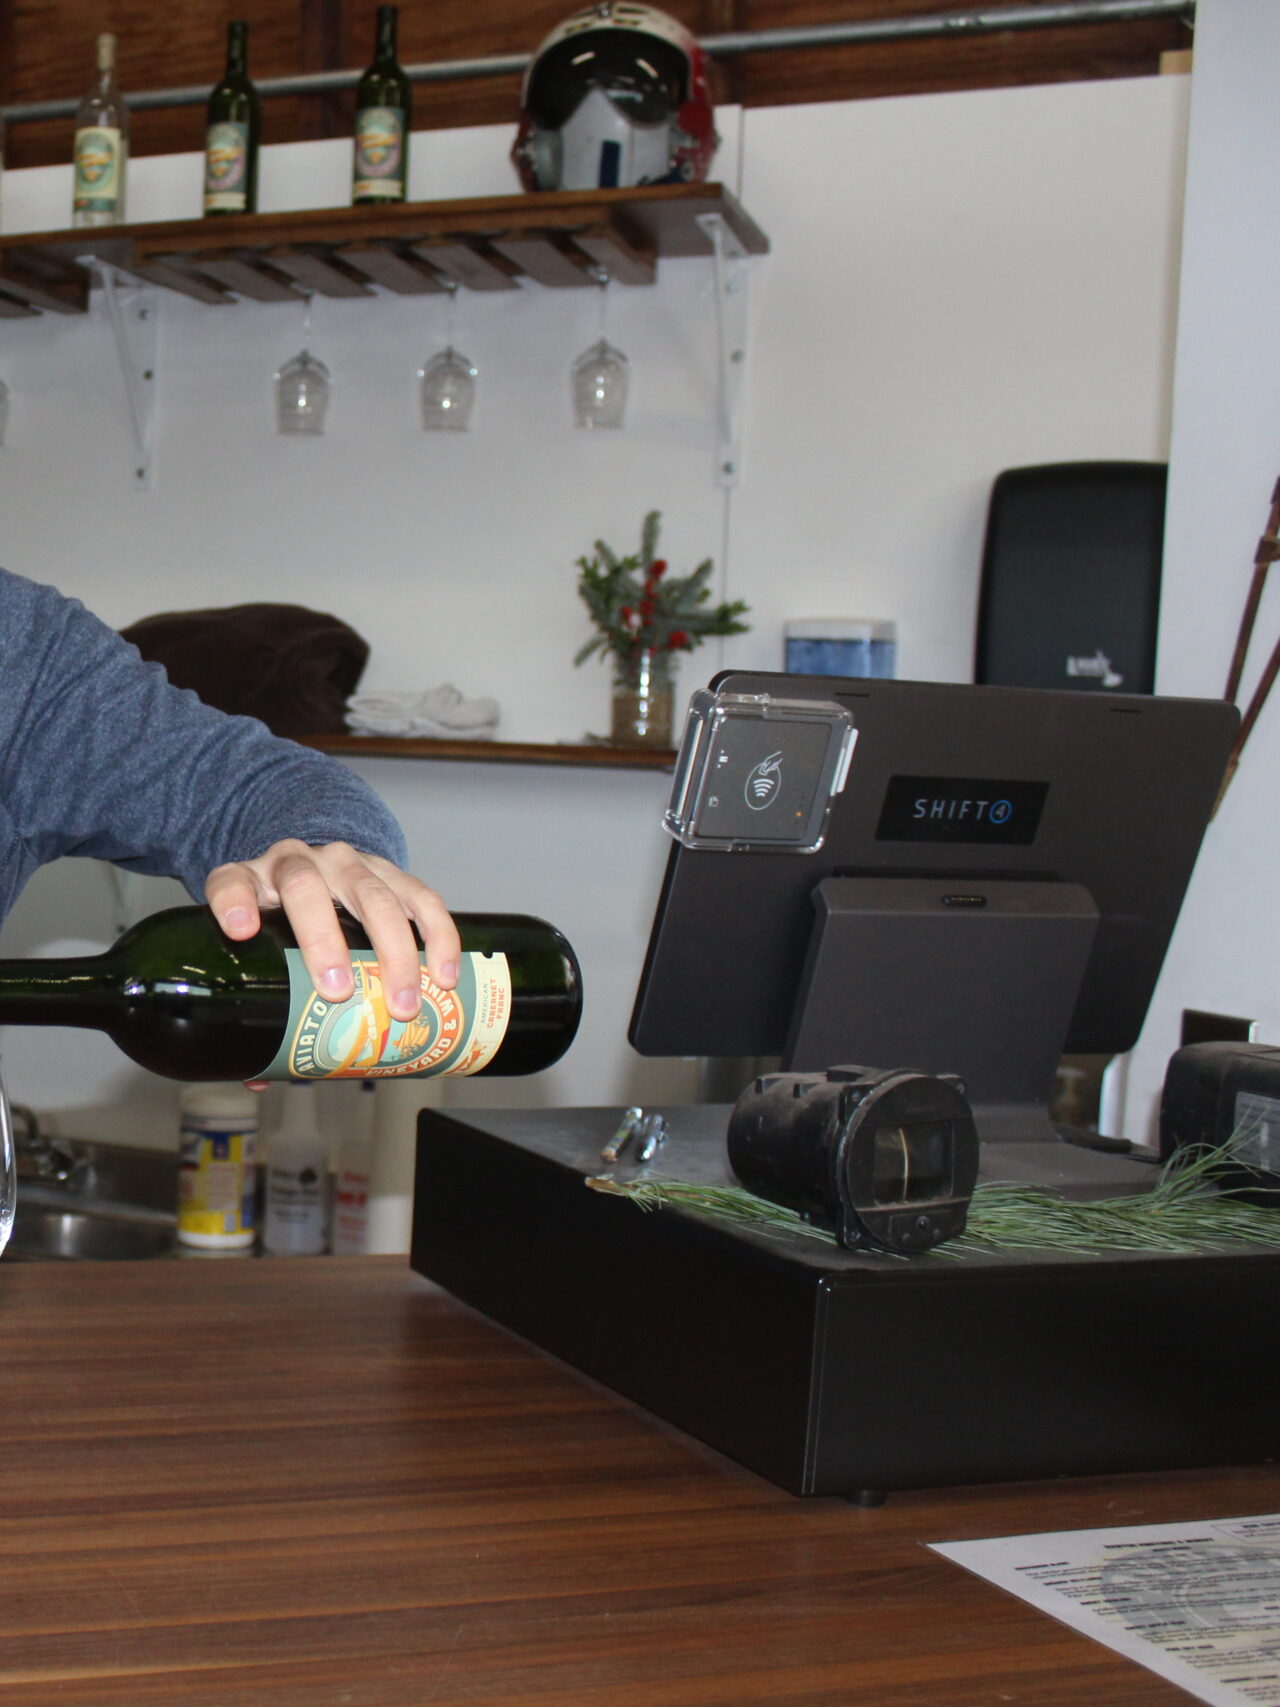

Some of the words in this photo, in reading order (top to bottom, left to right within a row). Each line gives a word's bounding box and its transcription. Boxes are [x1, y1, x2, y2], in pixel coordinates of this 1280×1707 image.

[480, 983, 489, 1024] AMERICAN
[486, 978, 498, 1028] CABERNET
[496, 988, 505, 1020] FRANC
[295, 1001, 328, 1073] AVIATO
[364, 1037, 452, 1077] VINEYARD
[443, 1018, 457, 1031] &
